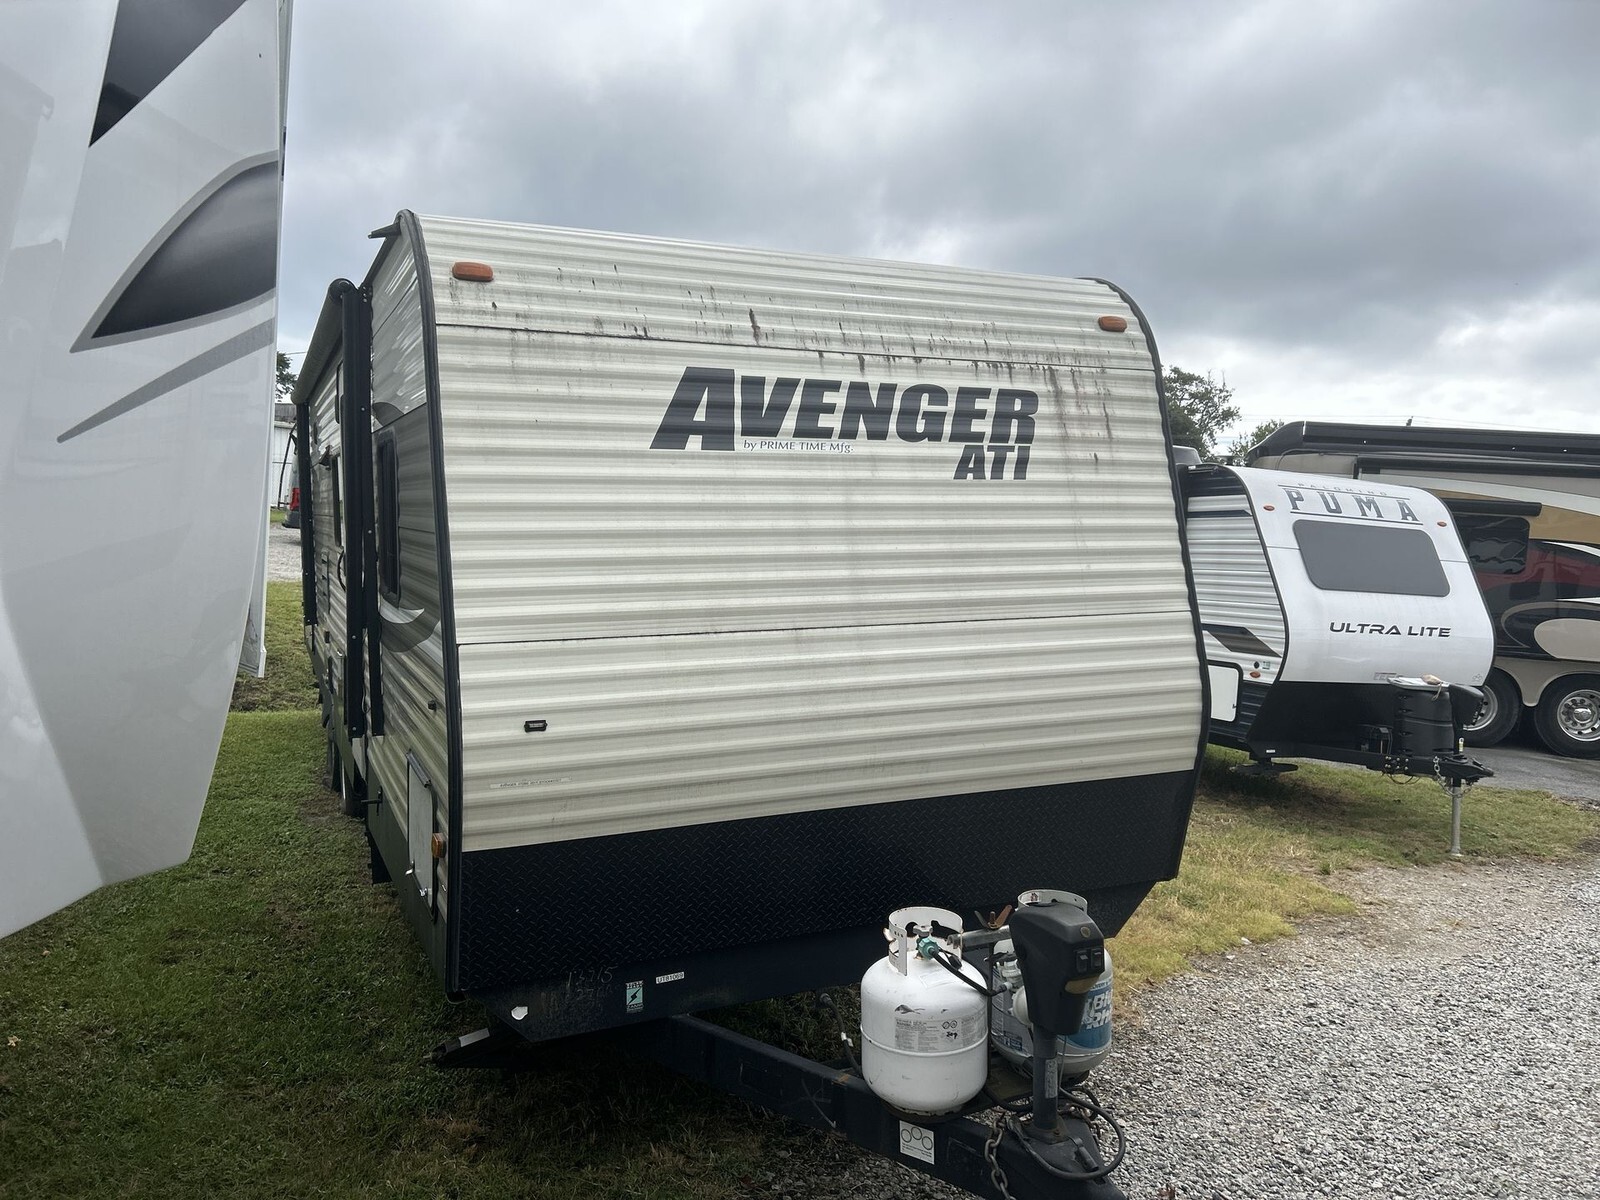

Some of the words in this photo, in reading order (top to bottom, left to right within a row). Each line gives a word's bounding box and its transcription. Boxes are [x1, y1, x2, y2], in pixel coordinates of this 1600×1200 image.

[649, 366, 1039, 451] AVENGER
[743, 440, 757, 451] by
[760, 441, 795, 450] PRIME
[799, 441, 827, 451] TIME
[829, 442, 854, 453] Mfg.
[953, 444, 1031, 480] ATI
[1283, 488, 1420, 521] PUMA
[1329, 622, 1401, 635] ULTRA
[1407, 626, 1451, 637] LITE
